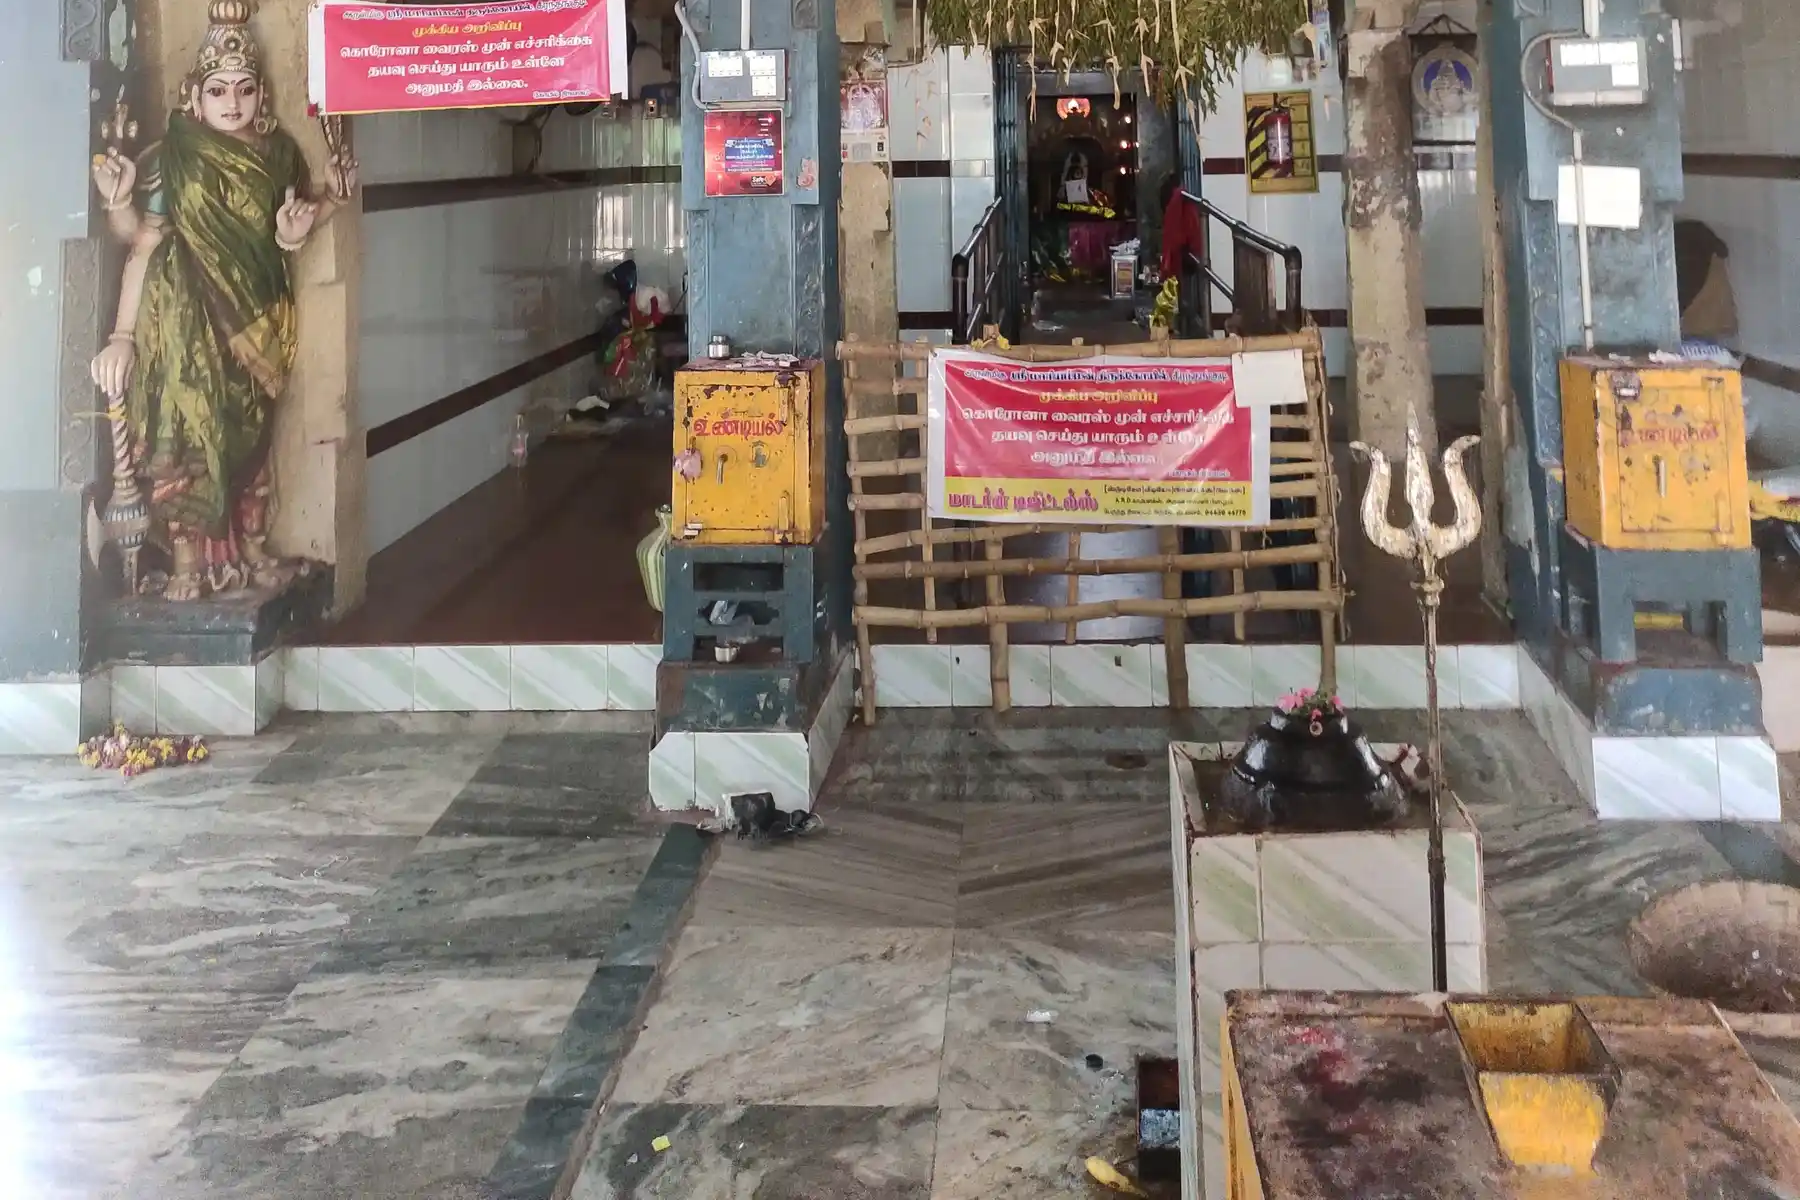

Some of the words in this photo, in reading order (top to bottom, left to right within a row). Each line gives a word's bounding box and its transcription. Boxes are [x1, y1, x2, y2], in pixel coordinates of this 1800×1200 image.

[412, 23, 458, 38] முக்கிய
[462, 20, 522, 35] அறிவிப்பு
[423, 42, 479, 56] வைரஸ்
[481, 38, 511, 54] முன்
[514, 34, 593, 50] எச்சரிக்கை
[367, 64, 405, 78] தயவு
[408, 59, 456, 75] செய்து
[460, 56, 508, 73] யாரும்
[512, 55, 565, 70] உள்ளே
[405, 79, 464, 97] அனுமதி
[1092, 388, 1159, 404] அறிவிப்பு
[693, 410, 783, 441] உண்டியல்
[1052, 408, 1111, 423] வைரஸ்
[1114, 409, 1147, 425] முன்
[991, 429, 1033, 444] தயவு
[1036, 428, 1088, 444] செய்து
[1091, 429, 1144, 444] யாரும்
